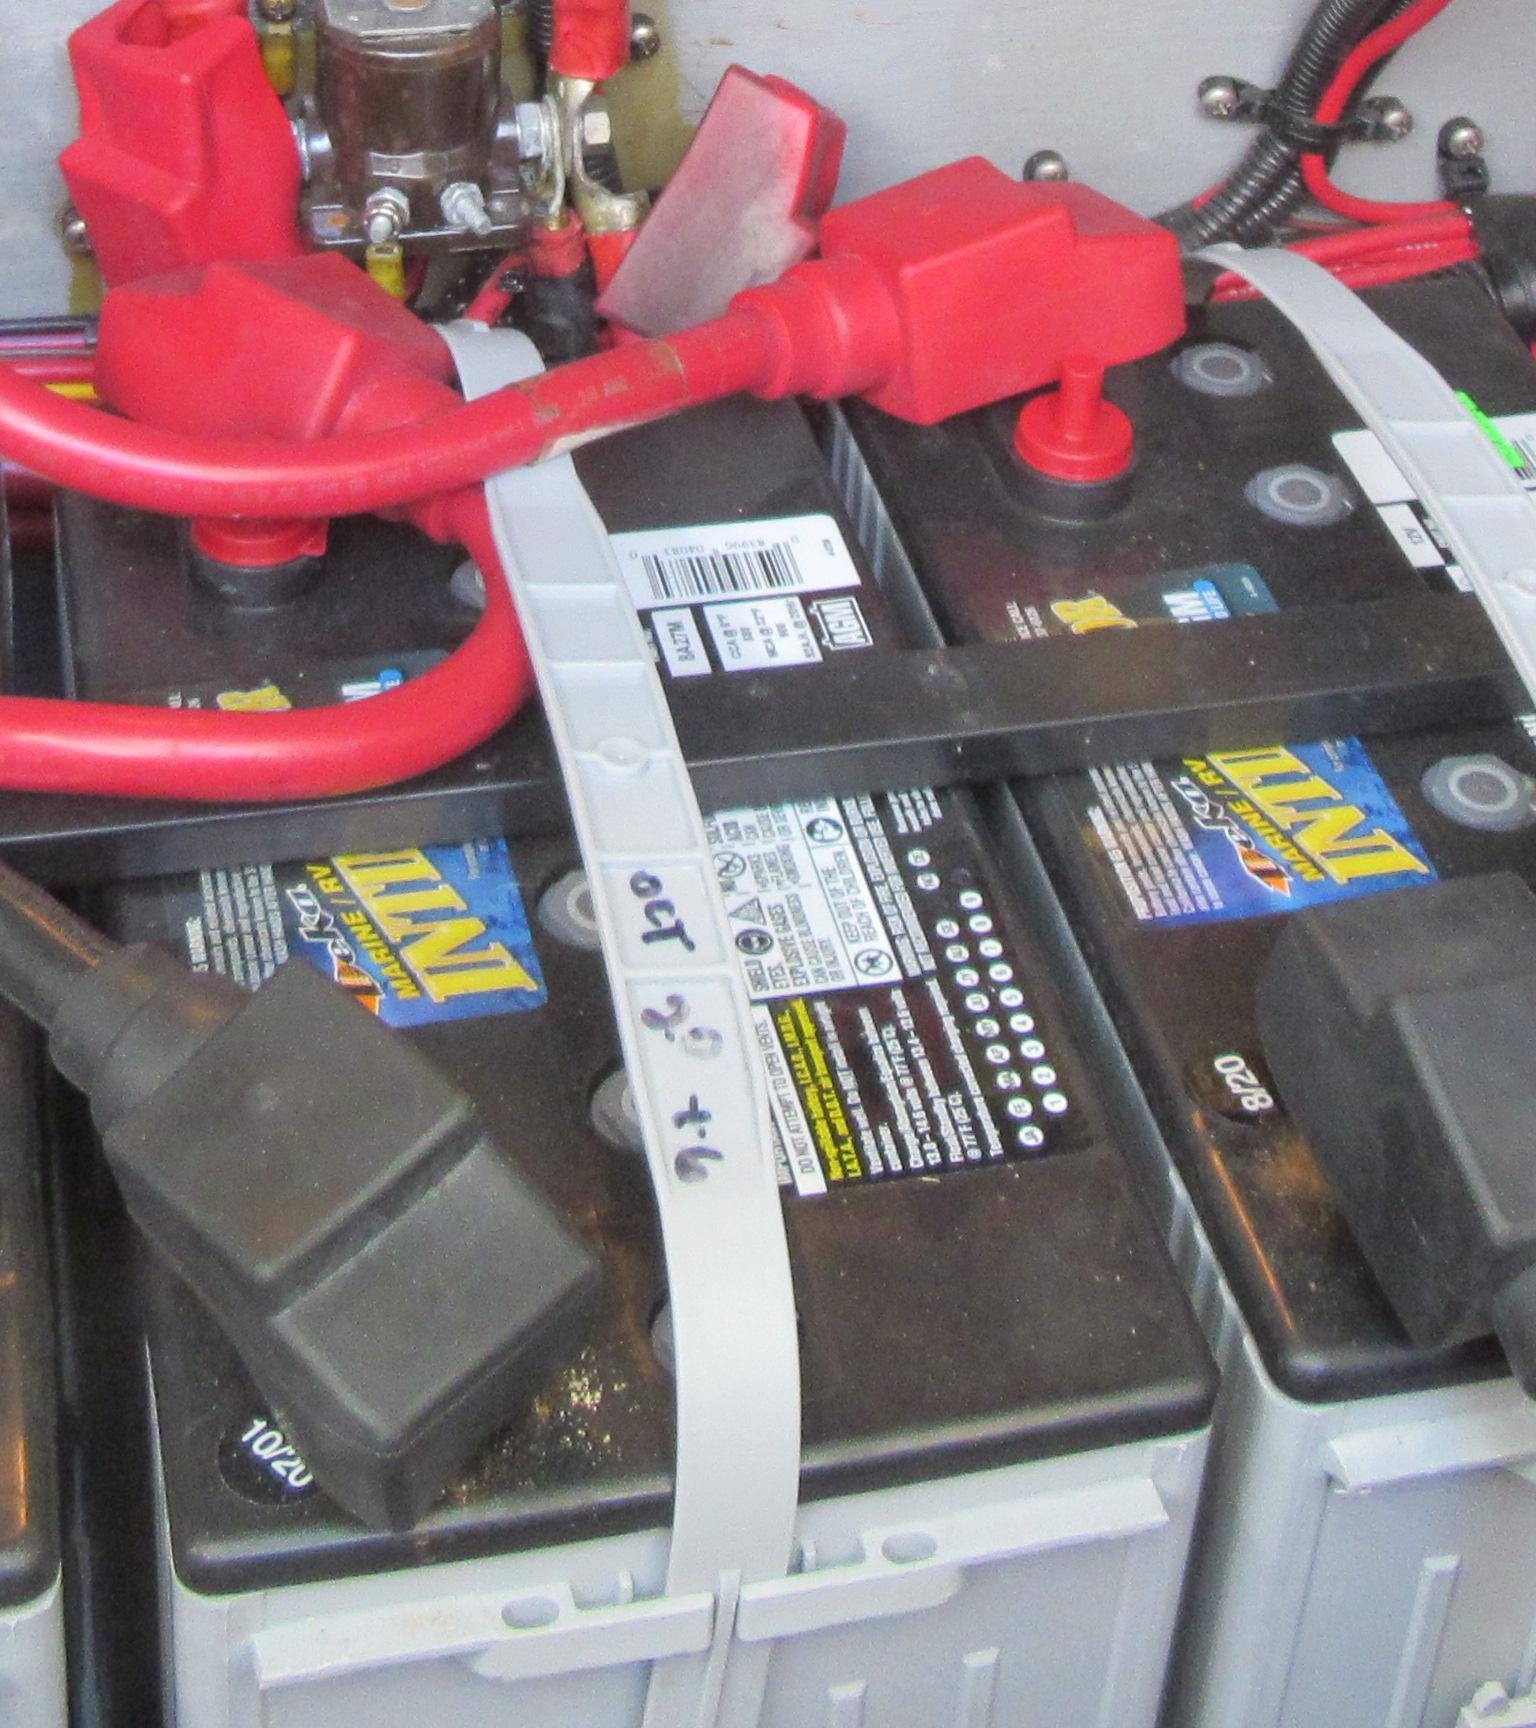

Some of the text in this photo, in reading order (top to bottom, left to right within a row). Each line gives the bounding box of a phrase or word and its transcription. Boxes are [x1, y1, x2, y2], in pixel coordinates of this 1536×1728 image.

[1181, 756, 1325, 882] MARINE RV
[304, 863, 421, 1000] MARINE RV
[630, 868, 698, 952] OCT
[1211, 1052, 1275, 1115] 8/20
[238, 1418, 317, 1492] 10/20
